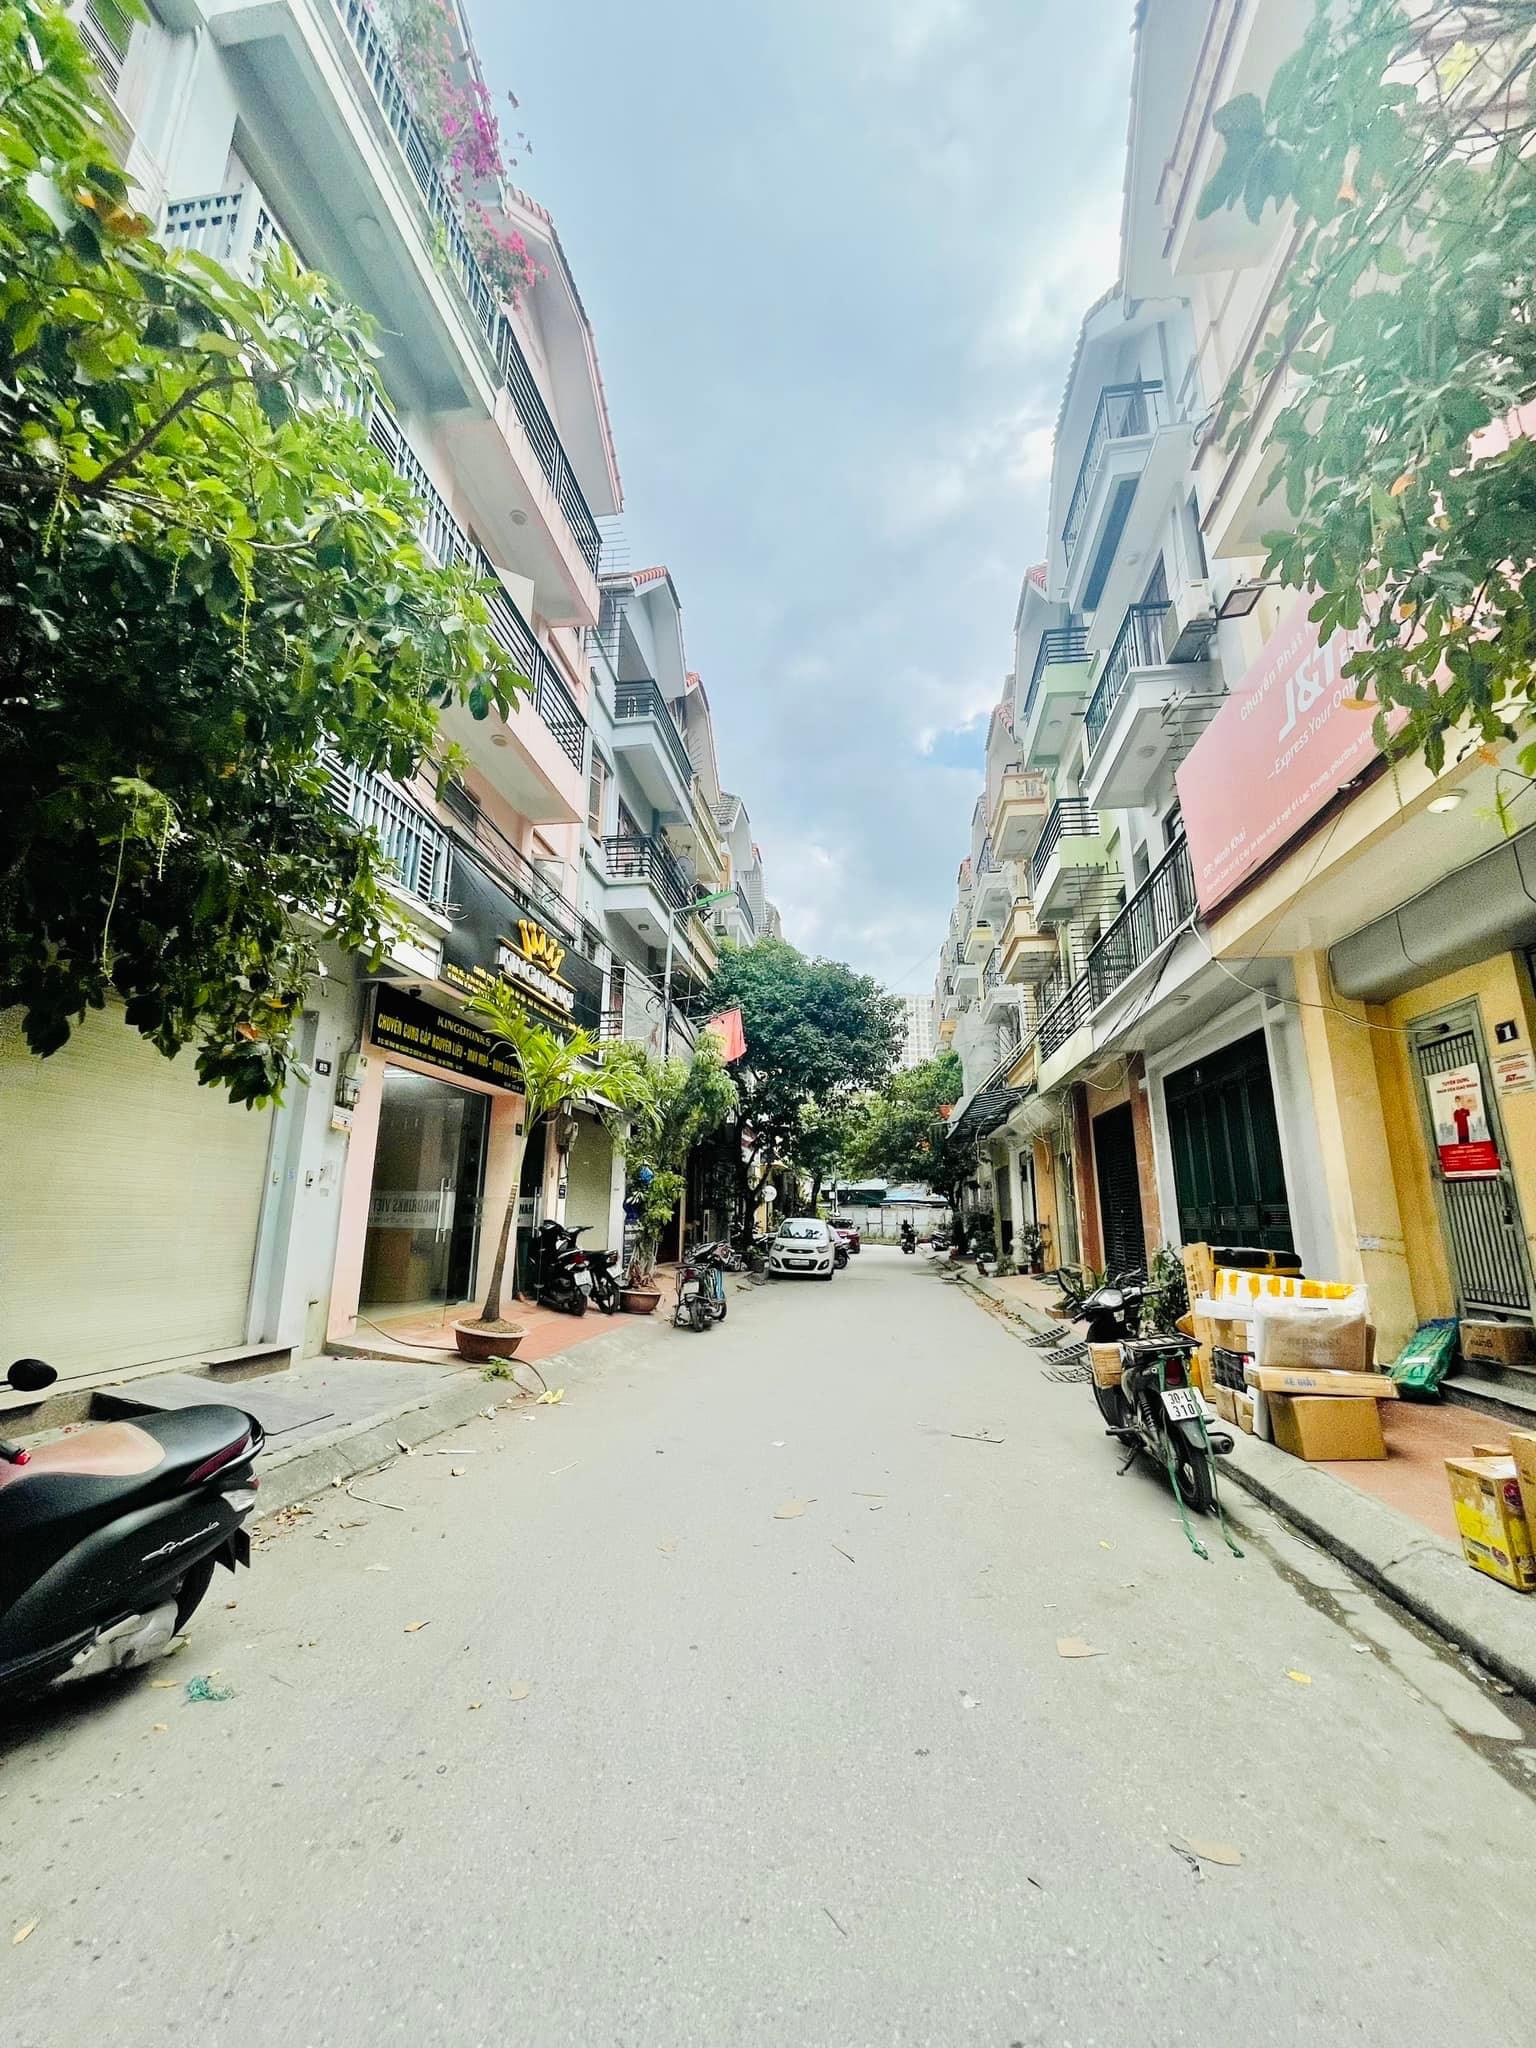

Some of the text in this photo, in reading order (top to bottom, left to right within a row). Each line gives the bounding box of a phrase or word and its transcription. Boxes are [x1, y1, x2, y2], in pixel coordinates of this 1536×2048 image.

[1278, 626, 1335, 745] J&T
[437, 1015, 491, 1048] KINGDRINKS
[1502, 1025, 1513, 1040] 1
